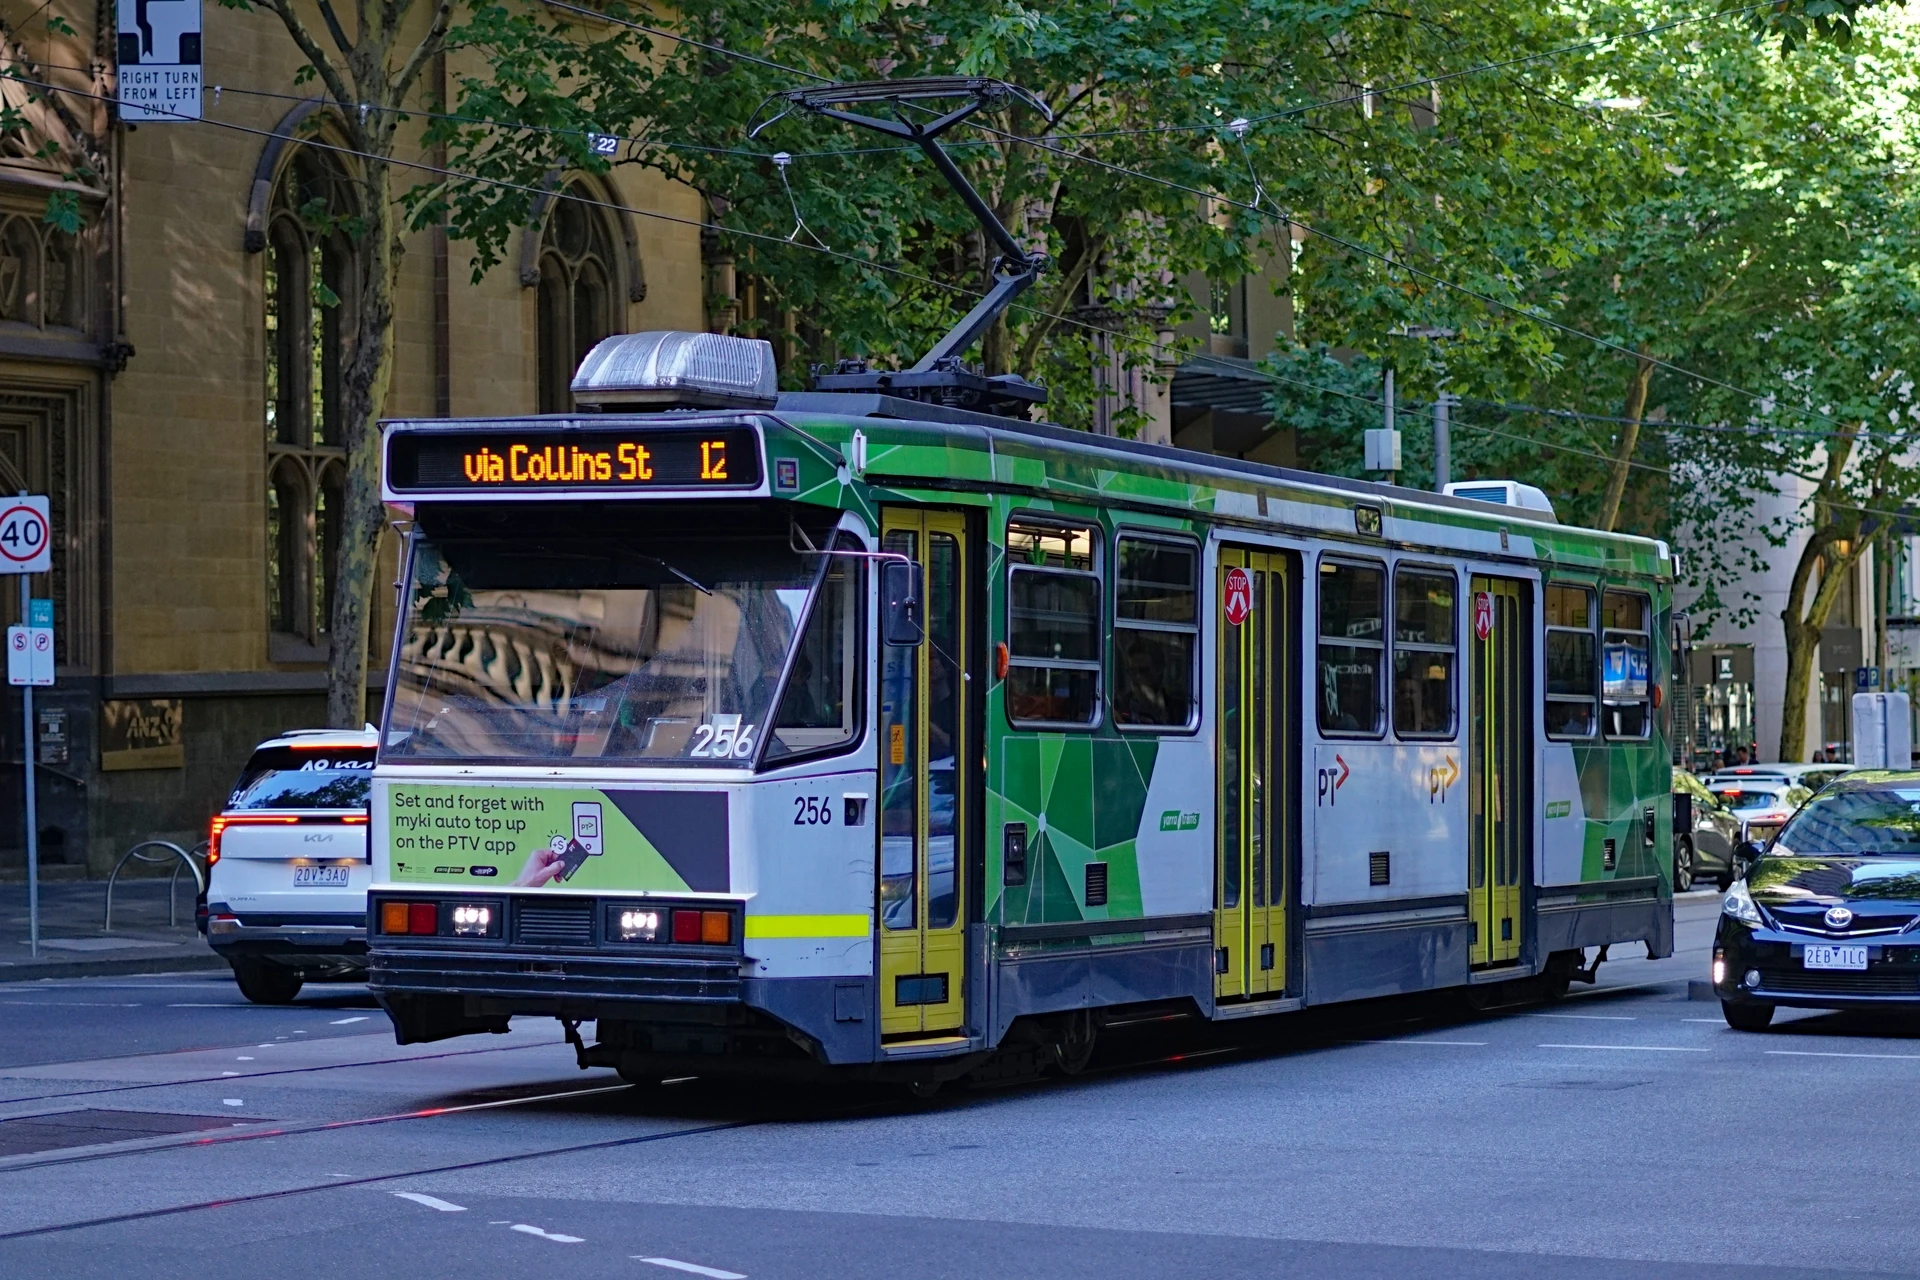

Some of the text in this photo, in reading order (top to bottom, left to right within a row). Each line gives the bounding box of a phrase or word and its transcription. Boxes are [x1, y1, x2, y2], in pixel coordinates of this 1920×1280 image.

[121, 72, 198, 84] RIGHT TURN
[124, 88, 196, 99] FROM LEFT
[143, 103, 177, 115] ONLY
[597, 137, 616, 152] 22
[464, 443, 653, 482] via Collins St
[700, 441, 728, 479] 12
[1, 520, 41, 547] 40
[1229, 576, 1247, 590] STOP
[690, 724, 755, 758] 256
[395, 792, 544, 813] Set and forget with
[793, 796, 832, 825] 256
[395, 813, 526, 834] myki auto top up
[396, 835, 516, 855] on the PTV app
[1807, 949, 1831, 964] 2EB
